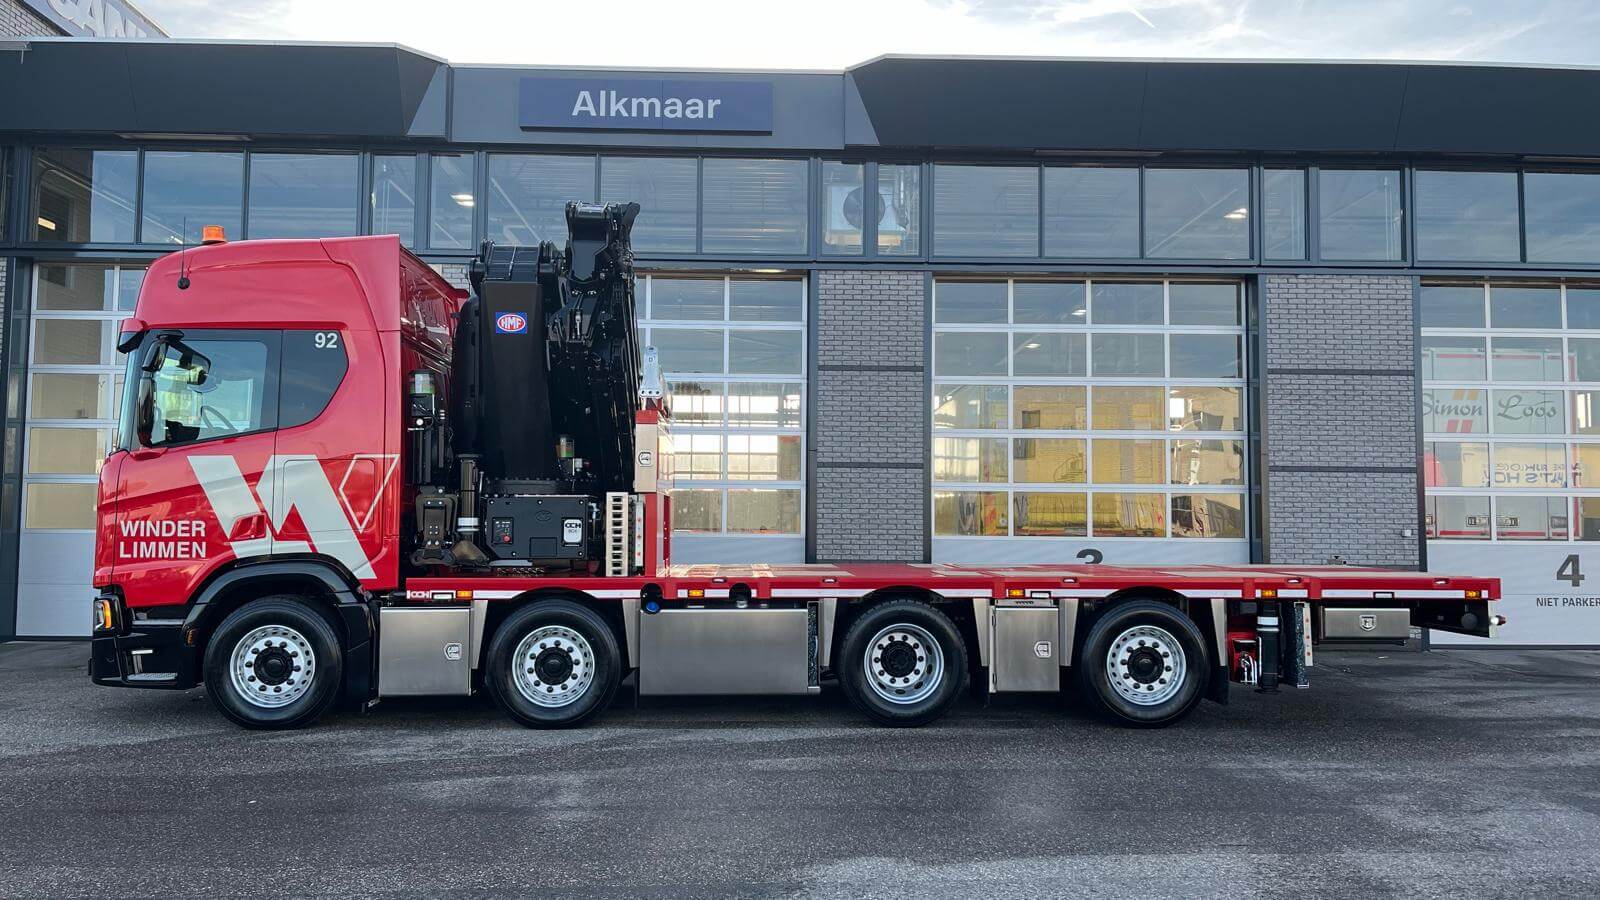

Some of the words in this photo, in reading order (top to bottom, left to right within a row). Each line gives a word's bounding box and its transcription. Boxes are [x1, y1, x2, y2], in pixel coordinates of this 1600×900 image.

[571, 89, 721, 119] Alkmaar
[500, 315, 523, 330] HMF
[314, 332, 338, 349] 92
[1422, 393, 1483, 416] Simon
[1497, 394, 1557, 420] Loos
[120, 520, 206, 537] WINDER
[119, 541, 207, 558] LIMMEN
[1556, 554, 1585, 587] 4
[1536, 597, 1559, 607] NIET
